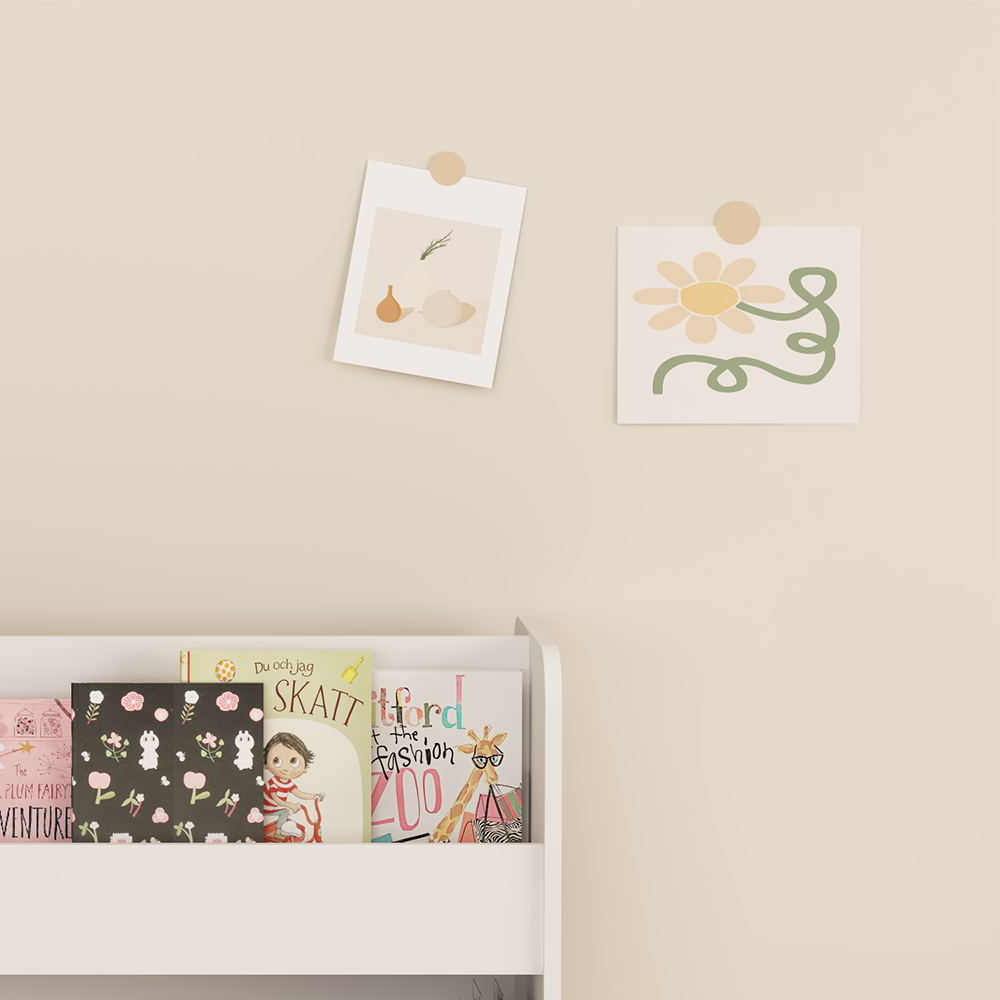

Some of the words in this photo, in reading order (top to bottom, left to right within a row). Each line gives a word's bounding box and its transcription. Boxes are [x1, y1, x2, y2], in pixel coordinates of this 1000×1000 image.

[254, 661, 270, 675] Du
[272, 658, 293, 671] och
[289, 659, 315, 678] jag
[273, 679, 365, 727] SKATT
[390, 726, 419, 745] the
[371, 737, 455, 781] fashion
[5, 783, 34, 800] PLUM
